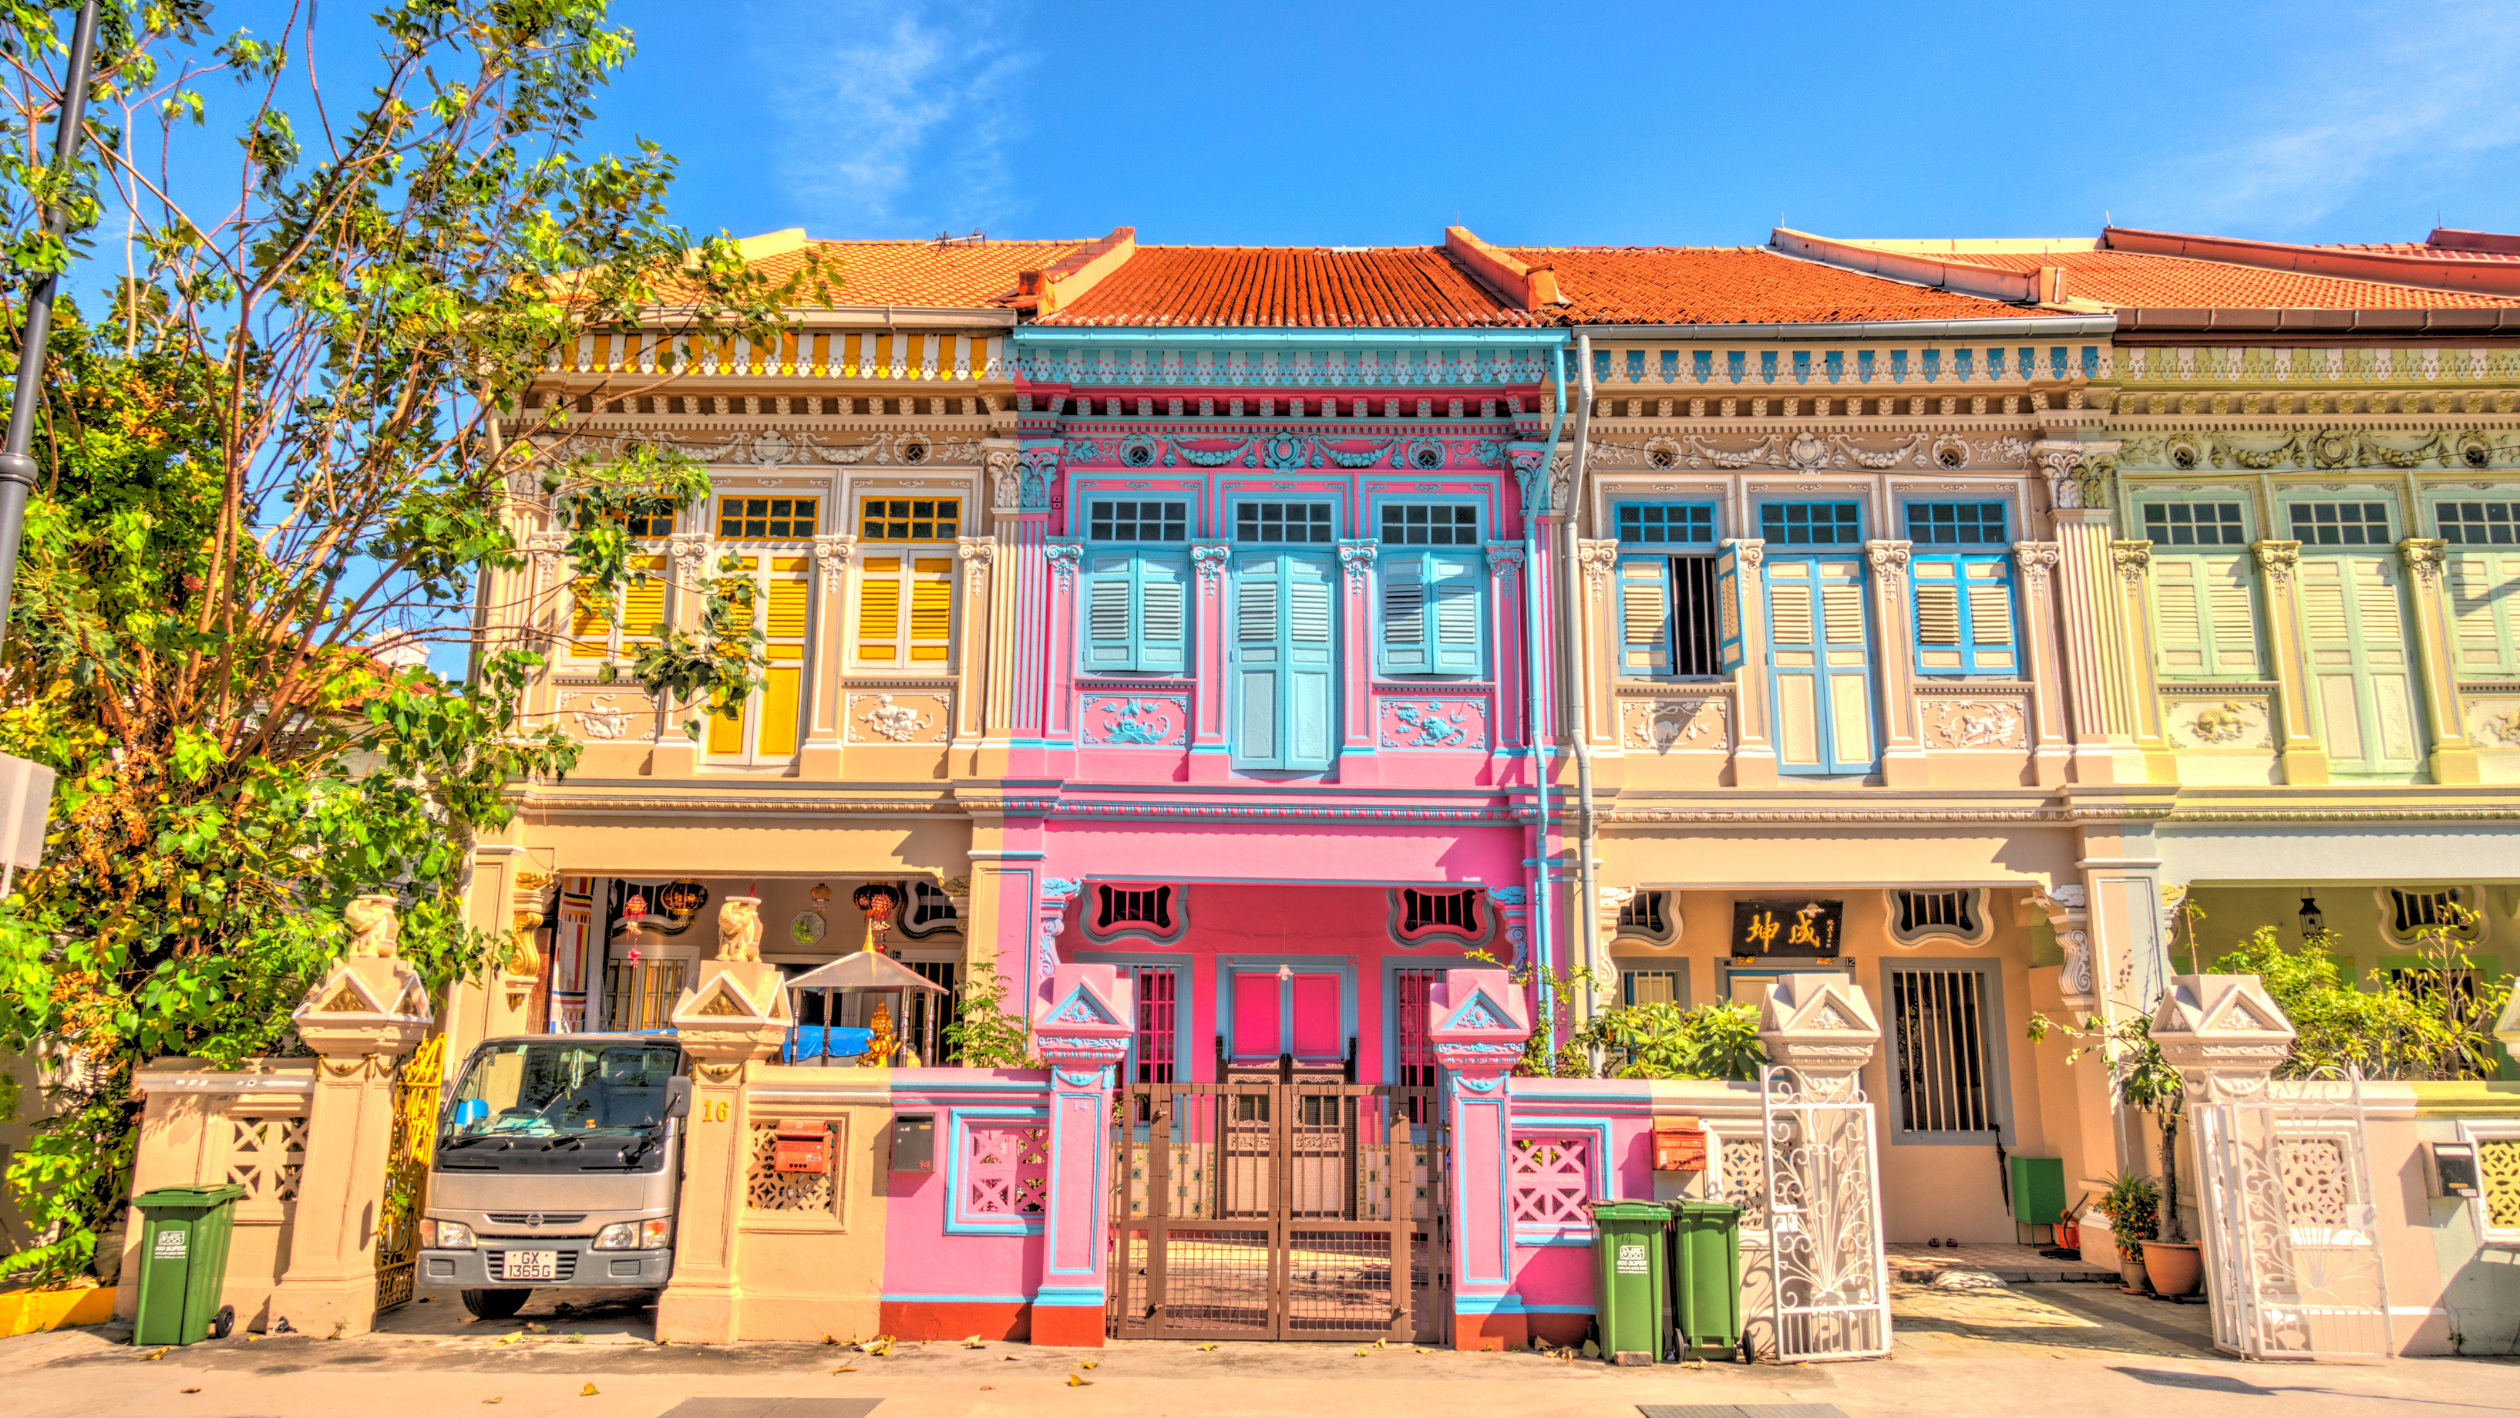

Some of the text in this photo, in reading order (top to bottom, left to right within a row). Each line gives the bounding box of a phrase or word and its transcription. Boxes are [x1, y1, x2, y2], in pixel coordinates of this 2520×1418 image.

[1346, 957, 1356, 966] 14
[1846, 957, 1855, 966] 12
[2344, 956, 2355, 966] 10
[703, 1100, 730, 1122] 16
[919, 1160, 930, 1169] 14
[521, 1252, 539, 1264] GX
[509, 1264, 551, 1277] 1365G
